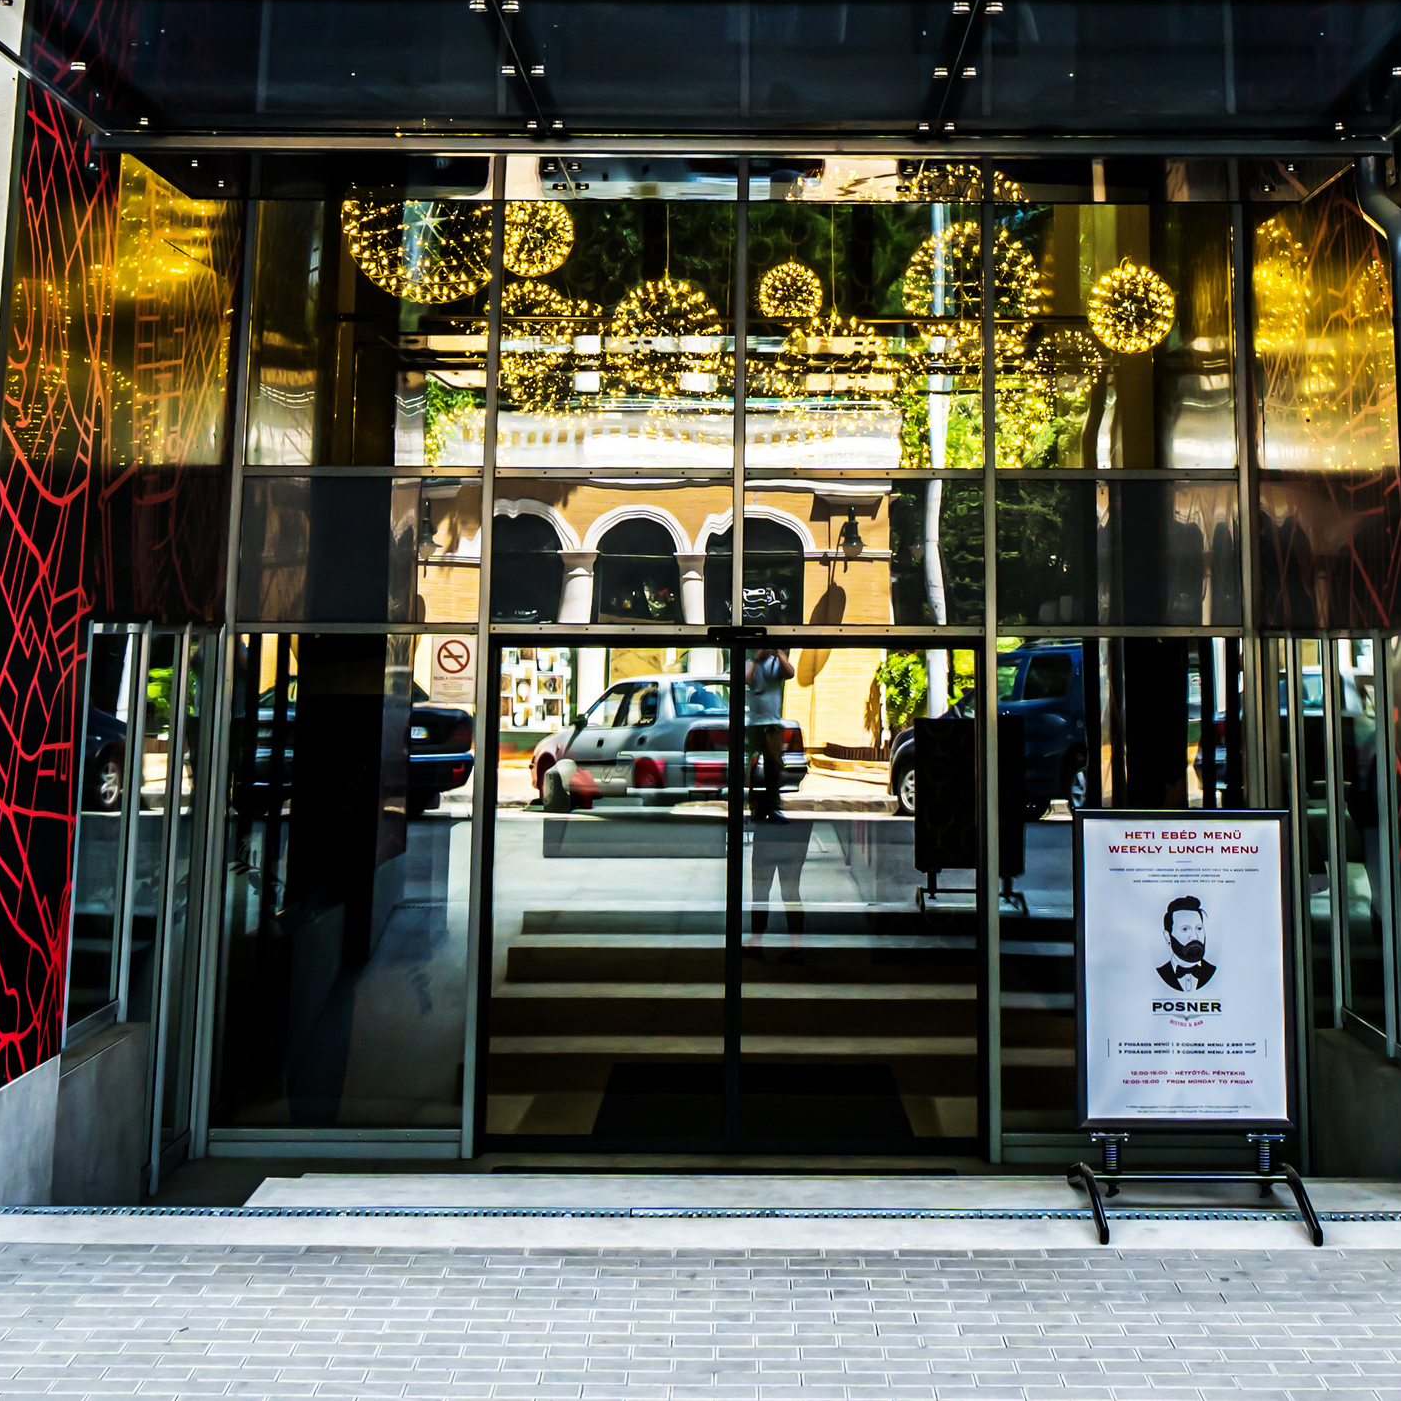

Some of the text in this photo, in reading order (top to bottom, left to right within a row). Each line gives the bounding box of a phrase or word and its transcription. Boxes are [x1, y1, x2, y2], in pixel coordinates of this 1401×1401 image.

[1124, 829, 1242, 839] HETI EBÉD MENÜ
[1108, 845, 1259, 854] WEEKLY LUNCH MENU
[1152, 1001, 1222, 1012] POSNER
[1169, 1019, 1187, 1027] BISTRO
